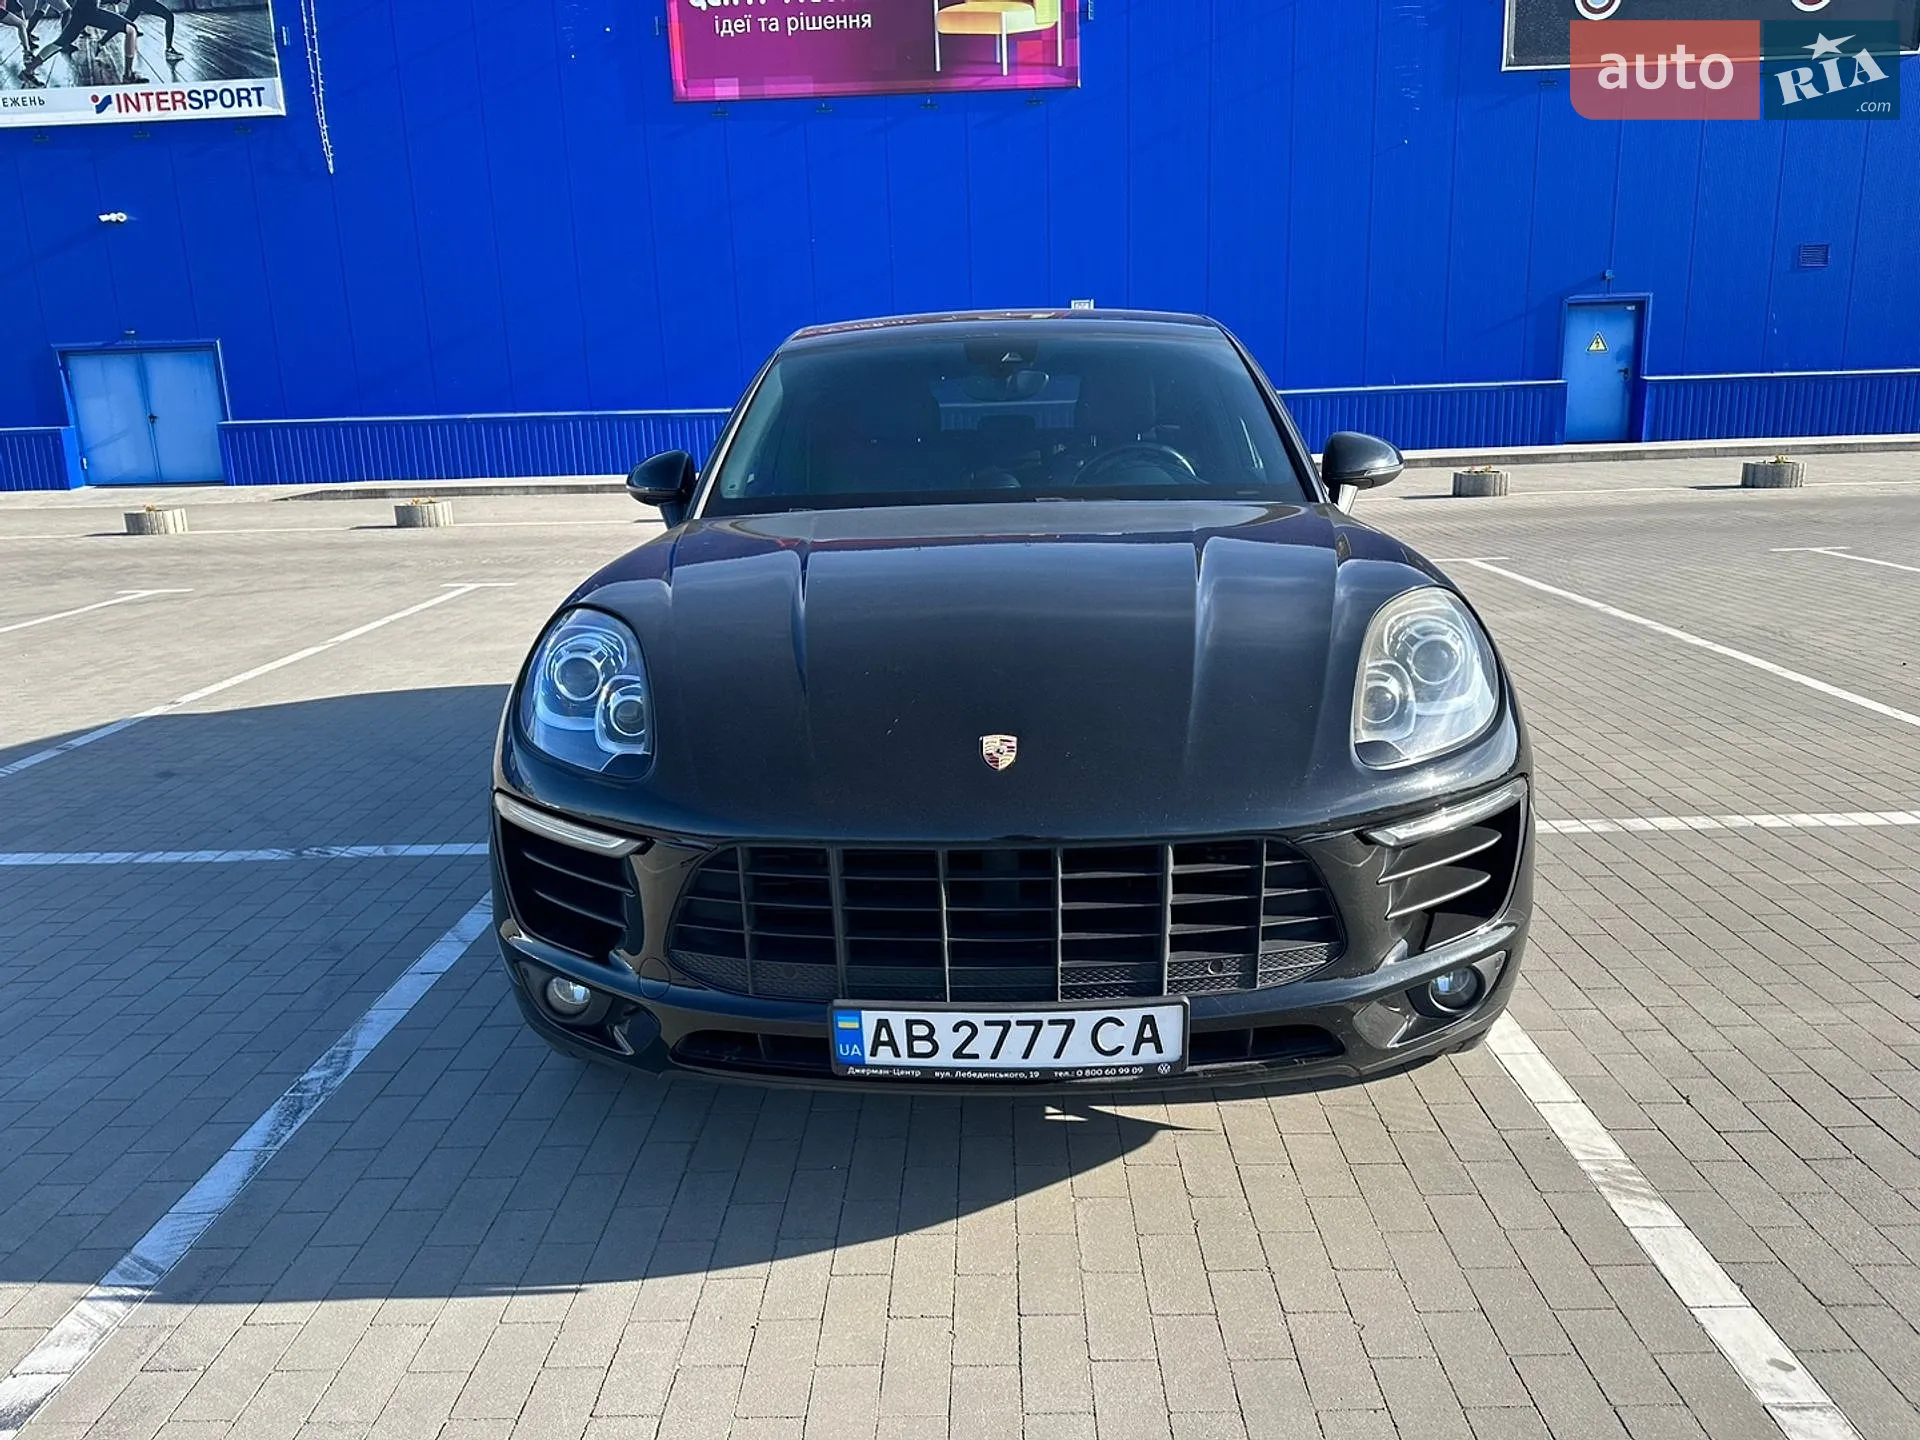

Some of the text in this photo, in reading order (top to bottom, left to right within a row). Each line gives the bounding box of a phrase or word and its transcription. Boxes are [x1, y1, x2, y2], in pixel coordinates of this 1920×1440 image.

[714, 12, 872, 37] ідеї та рішення
[115, 86, 266, 114] INTERSPORT
[869, 1014, 1164, 1060] AB 2777 CA
[838, 1044, 862, 1057] UA
[1084, 1068, 1103, 1077] 800
[1104, 1067, 1117, 1076] 60
[1118, 1066, 1130, 1075] 99
[1131, 1065, 1144, 1074] 09
